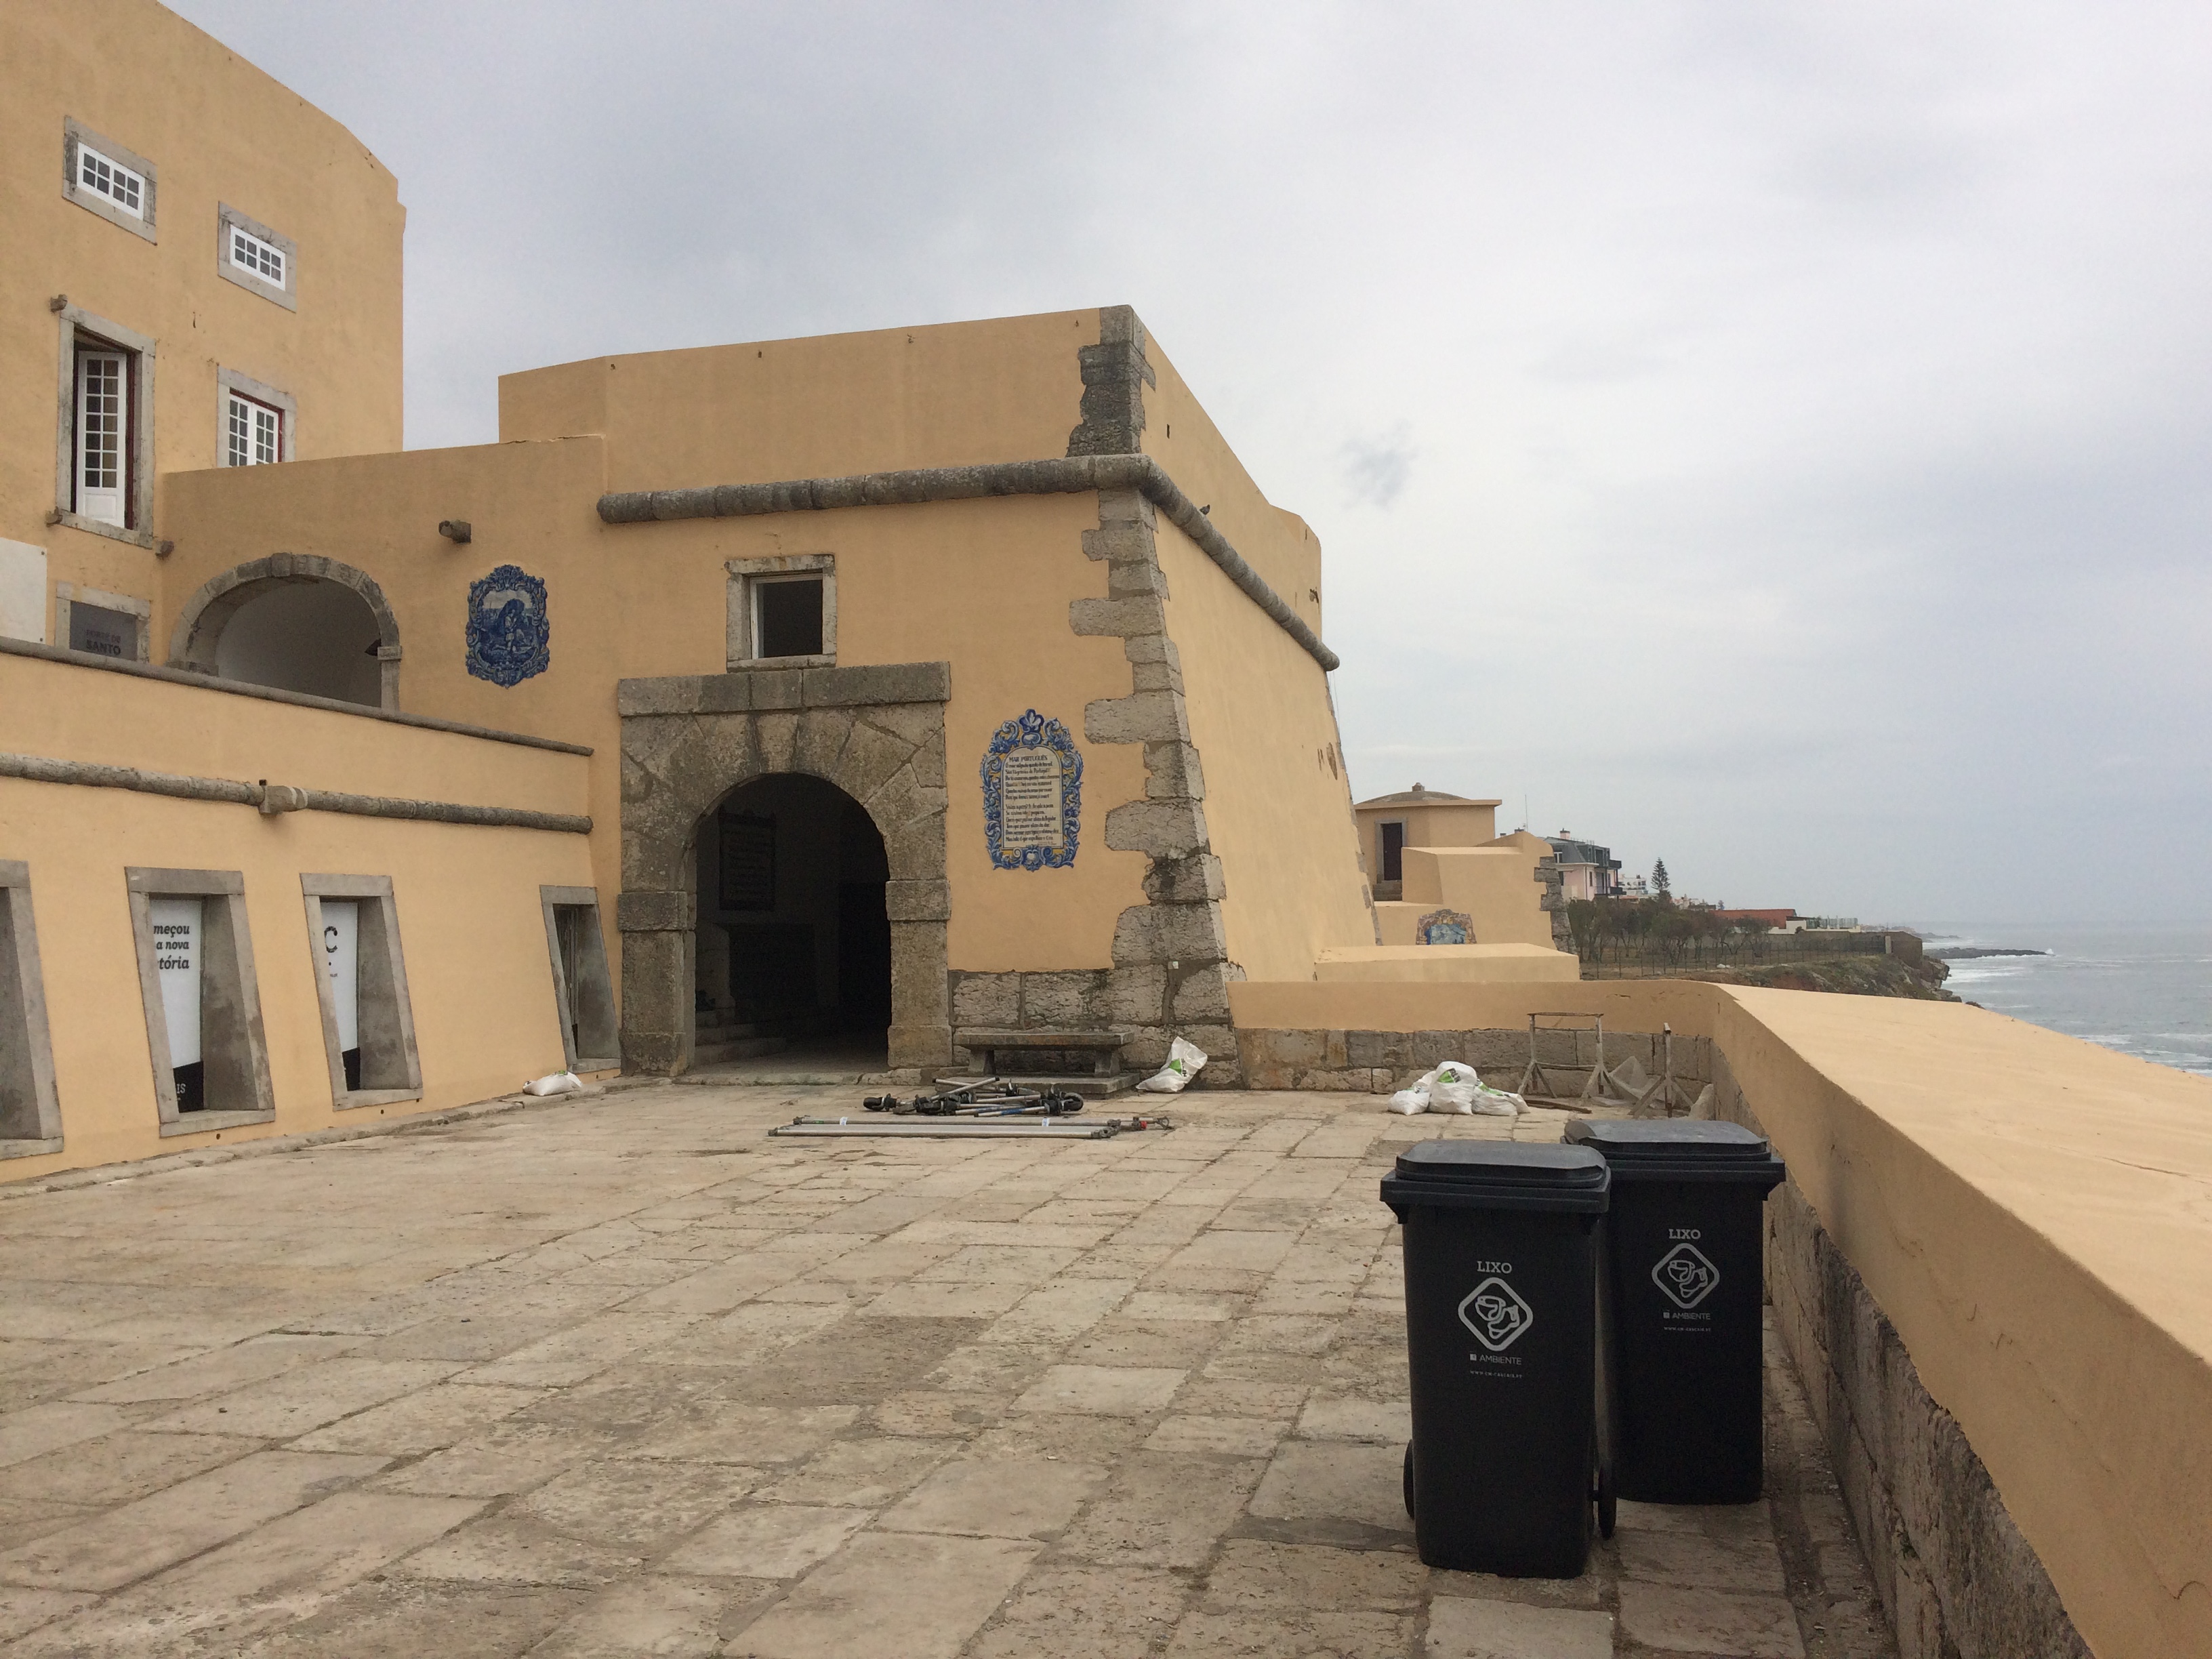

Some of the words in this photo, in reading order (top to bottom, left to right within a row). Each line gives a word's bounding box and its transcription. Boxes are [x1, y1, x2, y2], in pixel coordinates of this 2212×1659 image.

[86, 639, 121, 655] SANTO
[153, 925, 190, 938] meçou
[165, 941, 190, 950] nova
[157, 954, 190, 970] tória
[1668, 1228, 1701, 1240] LIXO
[1476, 1260, 1513, 1274] LIXO
[1671, 1312, 1711, 1320] AMBIENTE
[1479, 1354, 1522, 1365] AMBIENTE
